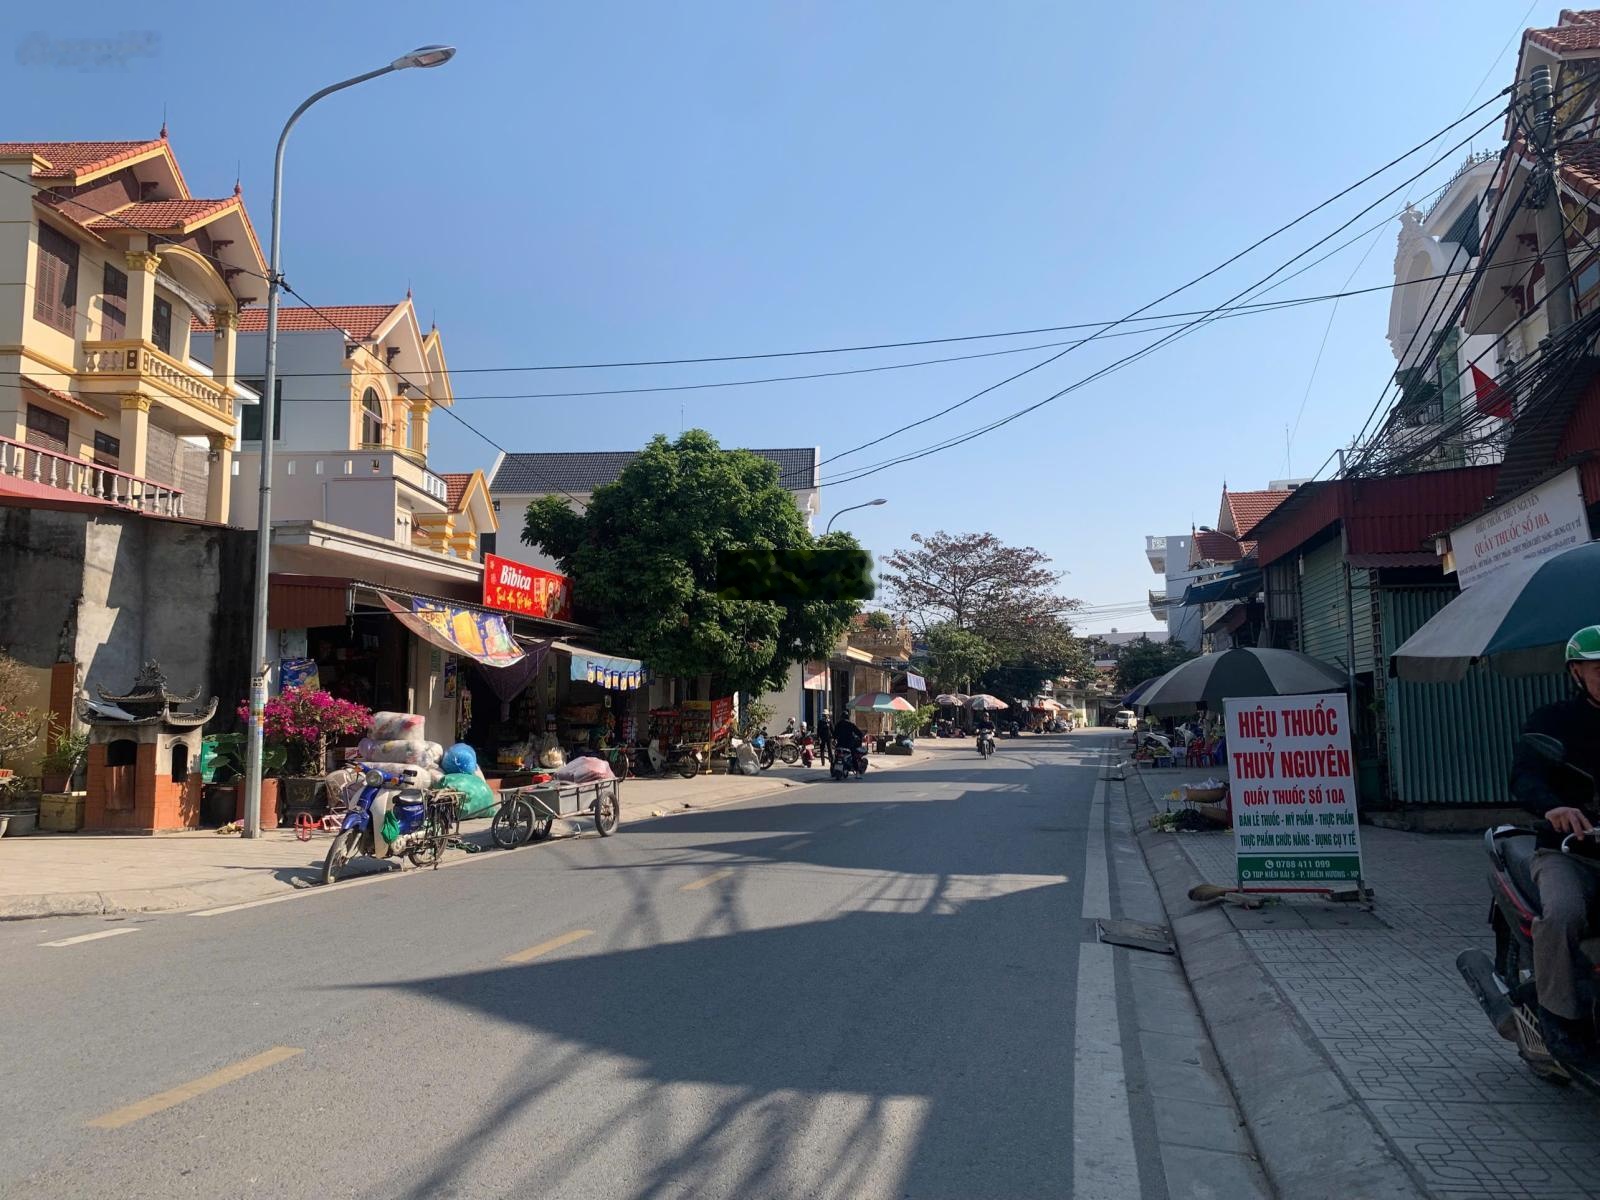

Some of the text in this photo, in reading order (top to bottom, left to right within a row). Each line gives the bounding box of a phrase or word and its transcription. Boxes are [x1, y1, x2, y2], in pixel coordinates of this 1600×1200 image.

[1495, 521, 1522, 548] THUỐC
[1523, 512, 1534, 534] SỐ
[1535, 512, 1550, 530] 10A
[500, 565, 532, 590] Bibica
[1238, 699, 1338, 744] HIỆU THUỐC
[1281, 744, 1351, 778] NGUYÊN
[1272, 784, 1305, 804] THUỐC
[1309, 784, 1322, 804] SỐ
[1326, 788, 1345, 804] 10A
[1261, 810, 1280, 826] THUỐC
[1276, 832, 1292, 846] CHỨC
[1293, 831, 1310, 846] NĂNG
[1315, 834, 1332, 848] DỤNG
[1333, 834, 1342, 848] CỤ
[1342, 834, 1347, 846] Y
[1348, 830, 1356, 846] TẾ
